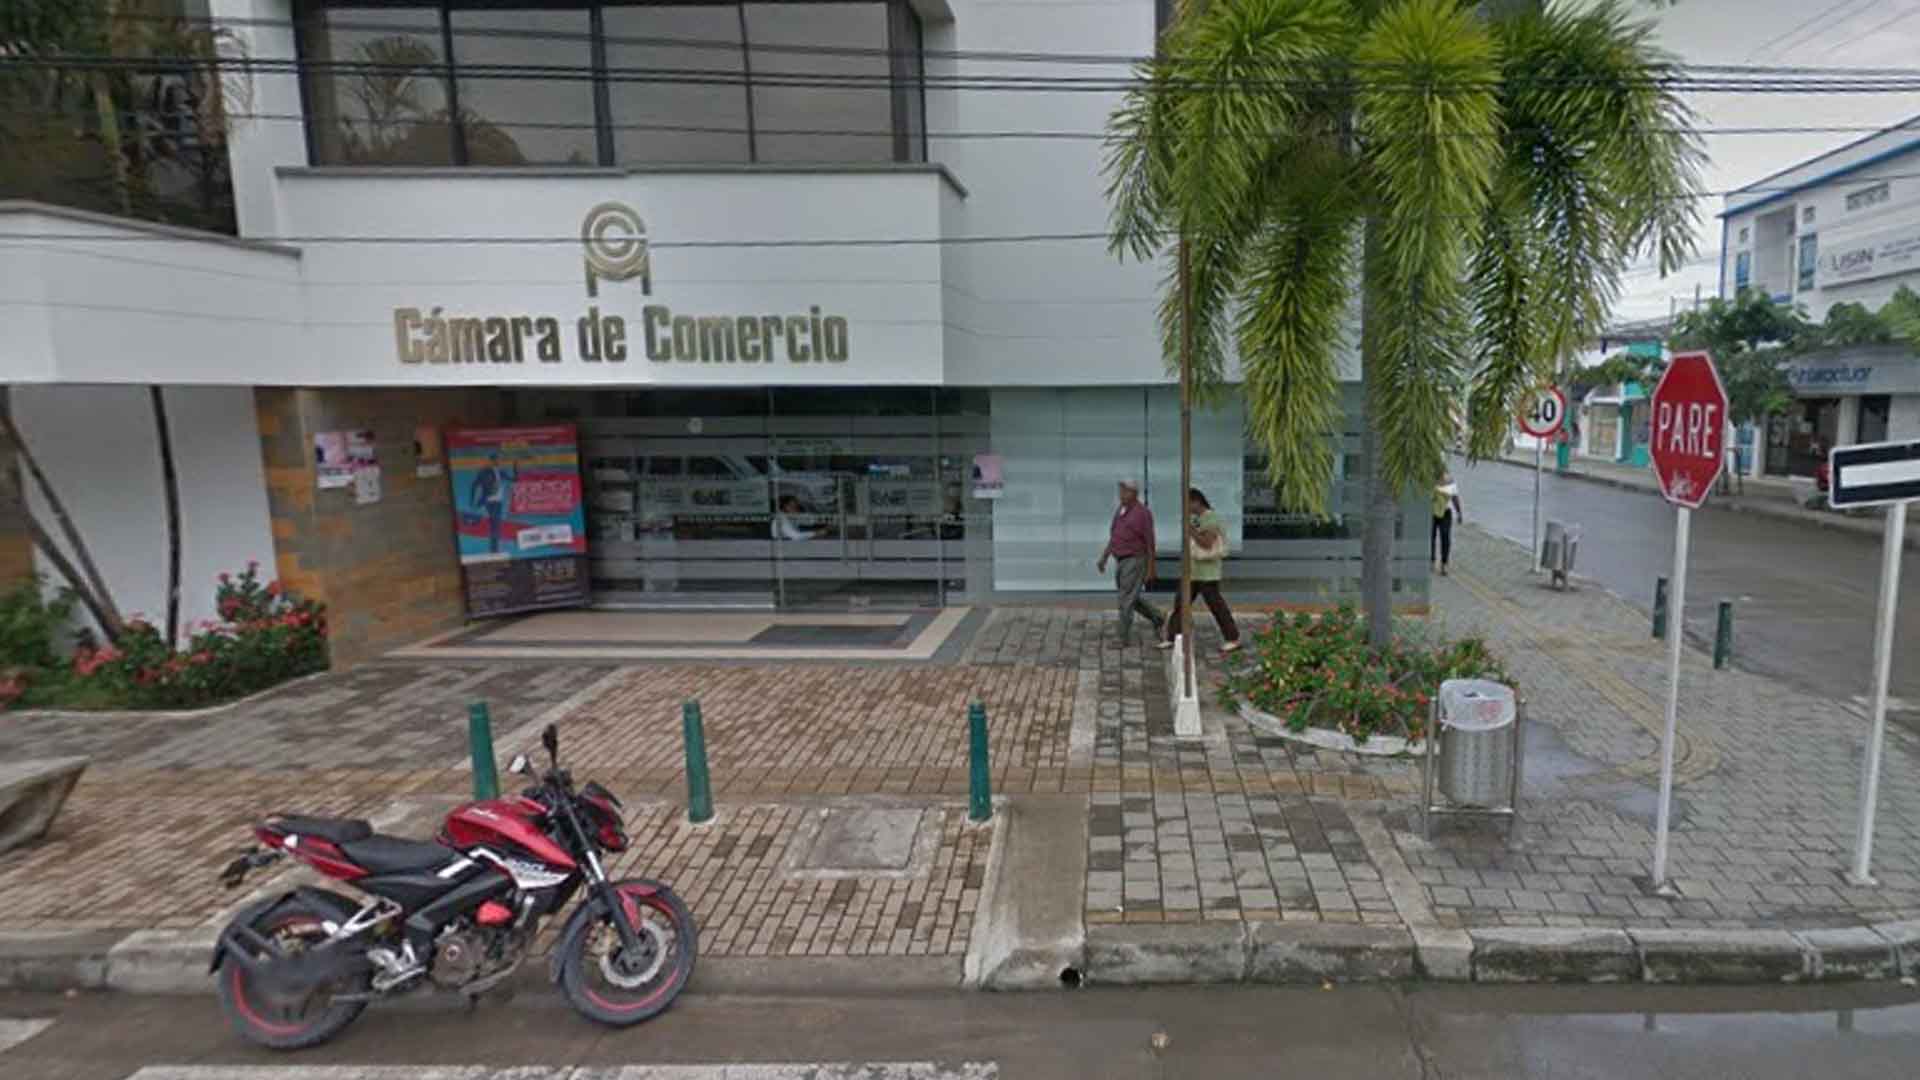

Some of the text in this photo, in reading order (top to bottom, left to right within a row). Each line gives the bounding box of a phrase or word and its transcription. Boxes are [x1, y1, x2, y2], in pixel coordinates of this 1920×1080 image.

[393, 304, 850, 363] Cámara de Comercio
[1526, 399, 1557, 423] 40
[1656, 401, 1718, 460] PARE
